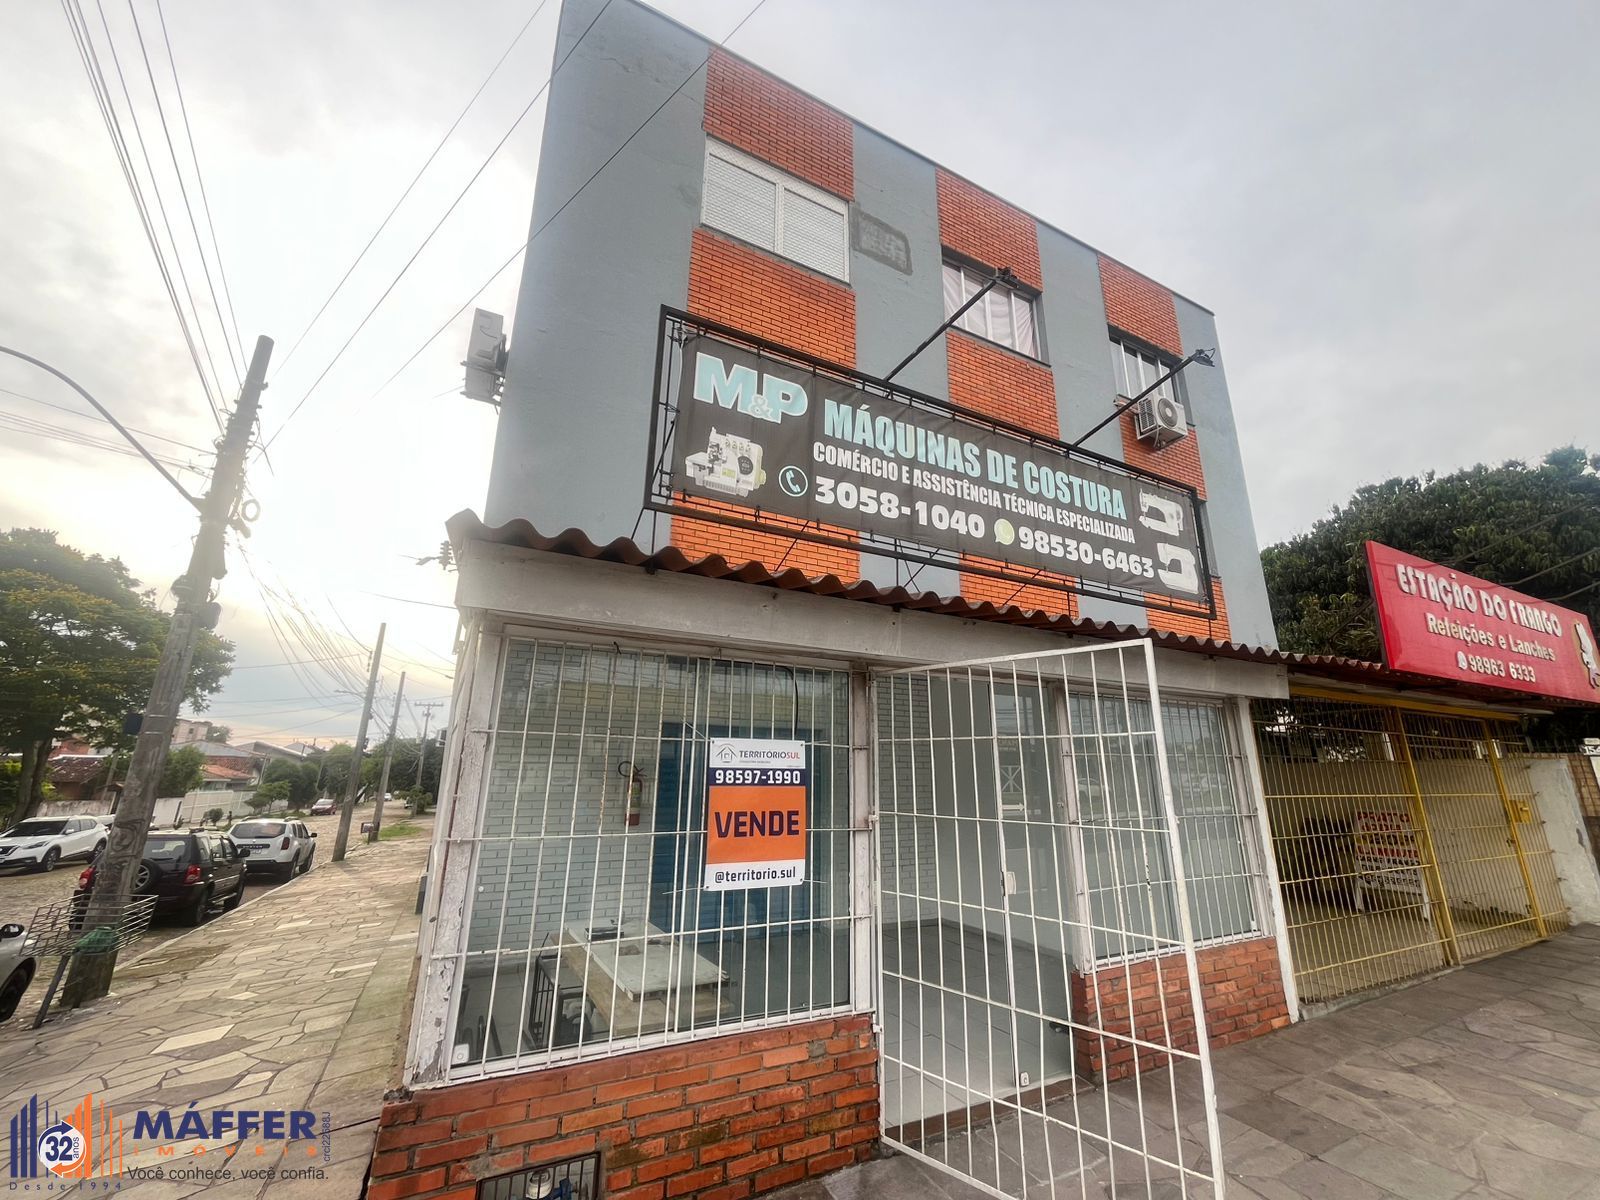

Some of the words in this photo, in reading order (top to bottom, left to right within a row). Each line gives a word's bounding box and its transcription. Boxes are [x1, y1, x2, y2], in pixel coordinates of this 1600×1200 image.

[693, 352, 808, 424] M&P
[824, 398, 981, 477] MÁQUINAS
[987, 448, 1018, 489] DE
[1023, 461, 1127, 520] COSTURA
[813, 441, 898, 481] COMÉRCIO
[902, 465, 910, 484] E
[913, 469, 1002, 508] ASSISTÊNCIA
[1003, 492, 1054, 523] TÉCNICA
[1056, 508, 1135, 544] ESPECIALIZADA
[815, 475, 985, 538] 3058-1040
[1018, 526, 1155, 578] 98530-6463
[1396, 563, 1477, 613] ESTAÇÃO
[1478, 589, 1506, 620] DO
[1509, 599, 1562, 637] FRANGO
[1425, 613, 1494, 647] Refeições
[1498, 634, 1507, 650] e
[1509, 633, 1556, 661] Lanches
[1468, 654, 1505, 677] 98963
[1509, 660, 1536, 683] 6333
[715, 770, 801, 784] 98597-1990
[714, 810, 800, 838] VENDE
[715, 866, 796, 883] @territorio.sul
